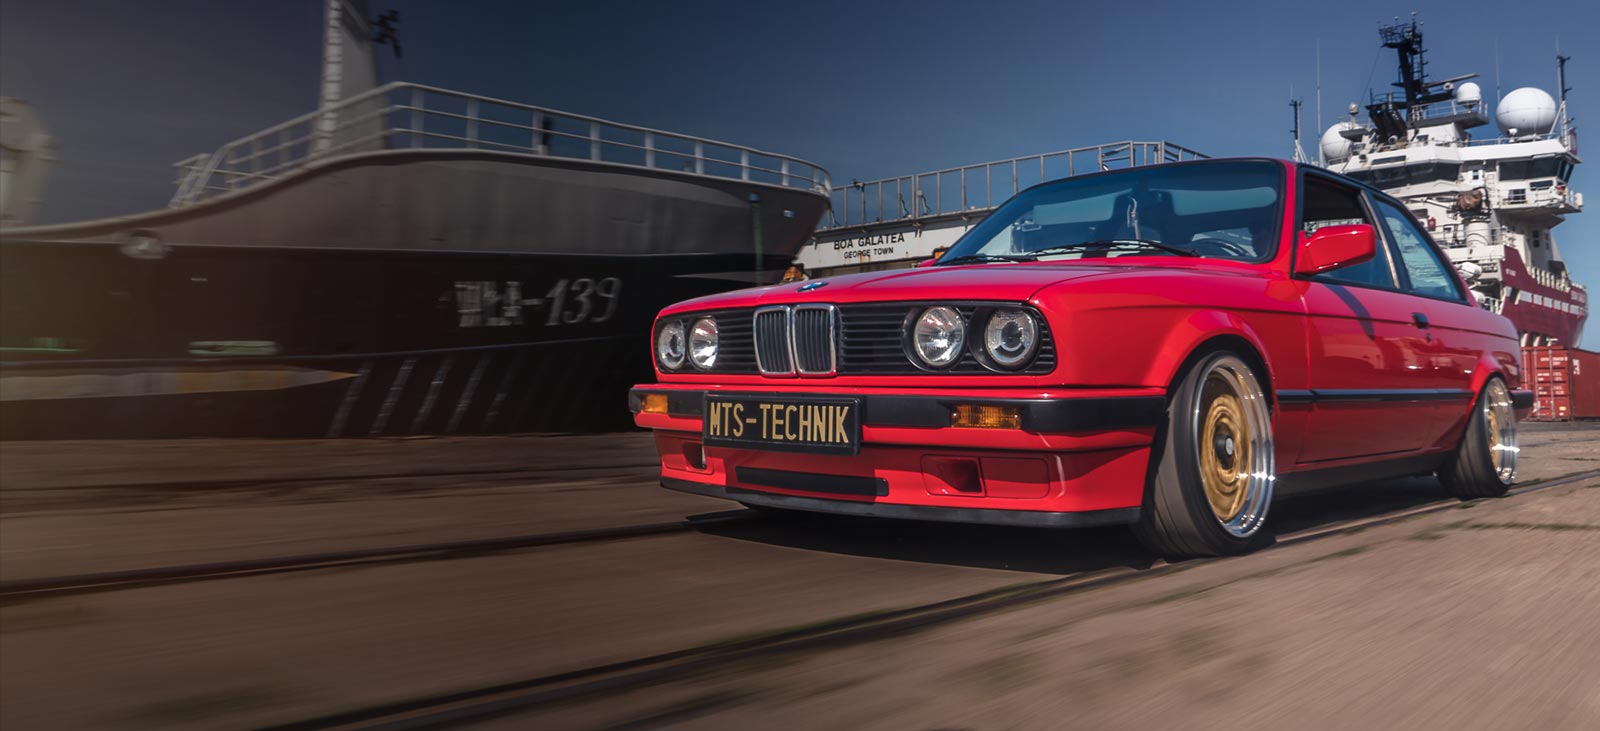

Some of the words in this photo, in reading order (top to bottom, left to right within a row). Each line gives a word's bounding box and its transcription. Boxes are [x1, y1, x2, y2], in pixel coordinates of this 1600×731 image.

[834, 239, 854, 250] BOA
[858, 232, 905, 247] GALATEA
[844, 249, 871, 259] GEORGE
[873, 247, 894, 256] TOWN
[709, 402, 849, 444] MTS-TECHNIK
